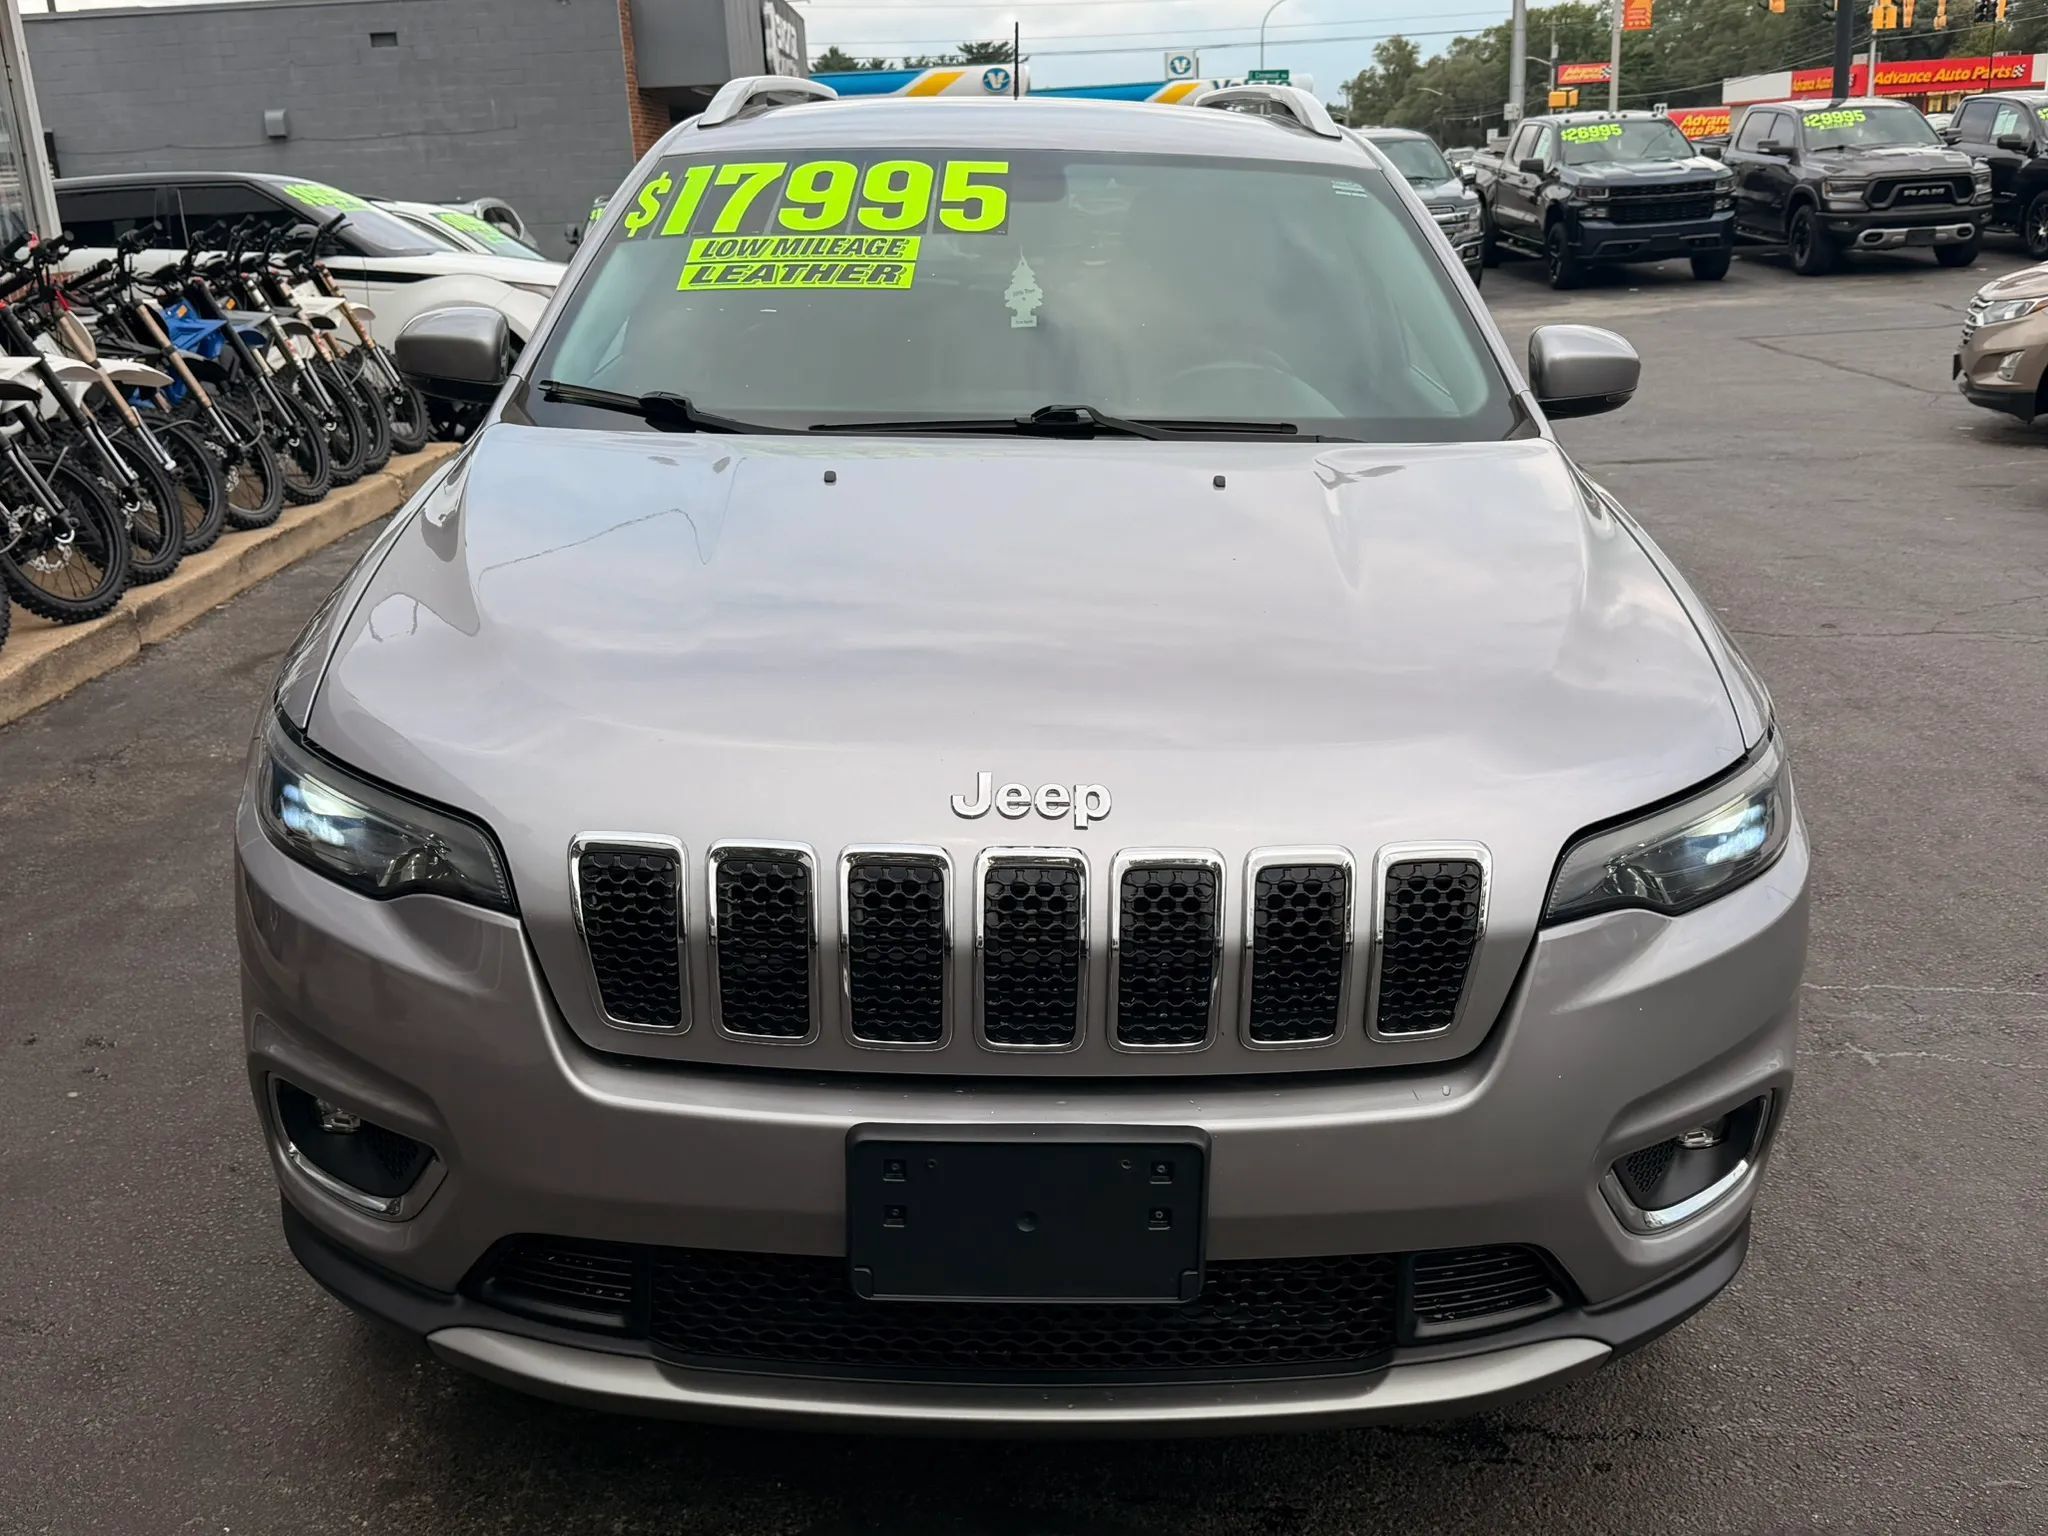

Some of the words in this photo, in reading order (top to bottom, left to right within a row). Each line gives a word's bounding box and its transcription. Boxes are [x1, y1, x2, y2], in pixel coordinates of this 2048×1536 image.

[1875, 71, 1932, 85] Advance
[1933, 68, 1971, 81] Auto
[1972, 66, 2011, 80] Parts
[1803, 110, 1866, 127] $29995
[1561, 123, 1622, 141] $26995
[624, 160, 1009, 238] $17995
[1903, 188, 1945, 197] RAM
[700, 238, 775, 260] LOW
[770, 237, 909, 259] MILEAGE
[688, 262, 909, 287] LEATHER
[950, 771, 1112, 830] Jeep
